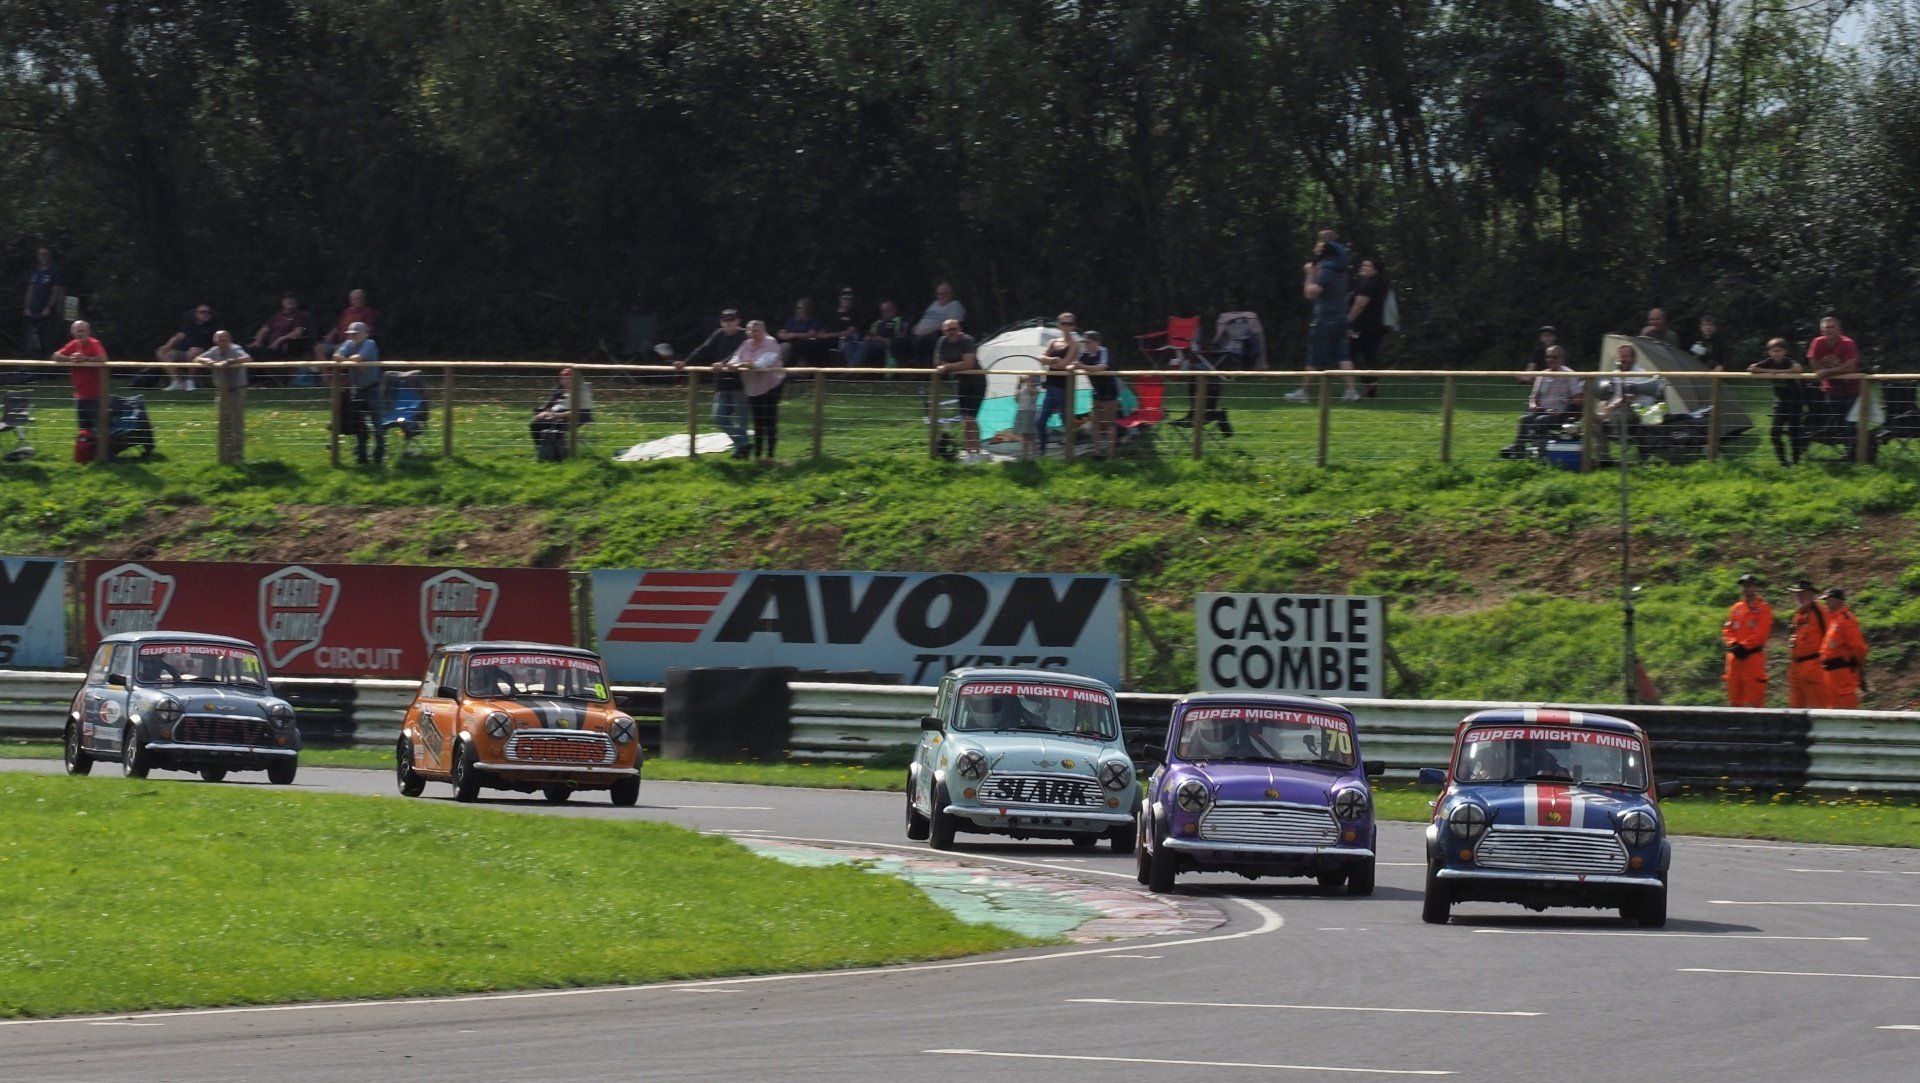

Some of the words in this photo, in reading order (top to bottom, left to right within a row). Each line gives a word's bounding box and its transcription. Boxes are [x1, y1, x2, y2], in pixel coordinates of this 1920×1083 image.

[712, 573, 1109, 649] AVON
[1209, 596, 1368, 643] CASTLE
[140, 646, 182, 656] SUPER
[185, 645, 227, 656] MIGHTY
[314, 646, 402, 670] CIRCUIT
[471, 656, 516, 667] SUPER
[520, 656, 565, 667] MIGHTY
[568, 659, 600, 673] MINIS
[1210, 644, 1369, 692] COMBE
[961, 685, 1012, 696] SUPER
[1017, 685, 1070, 698] MIGHTY
[1073, 690, 1111, 706] MINIS
[1185, 708, 1241, 721] SUPER
[1245, 708, 1302, 722] MIGHTY
[1306, 715, 1348, 732] MINIS
[1325, 729, 1351, 755] 70
[1465, 729, 1525, 743] SUPER
[1530, 729, 1592, 743] MIGHTY
[1596, 734, 1641, 751] MINIS
[994, 778, 1088, 806] SLARK
